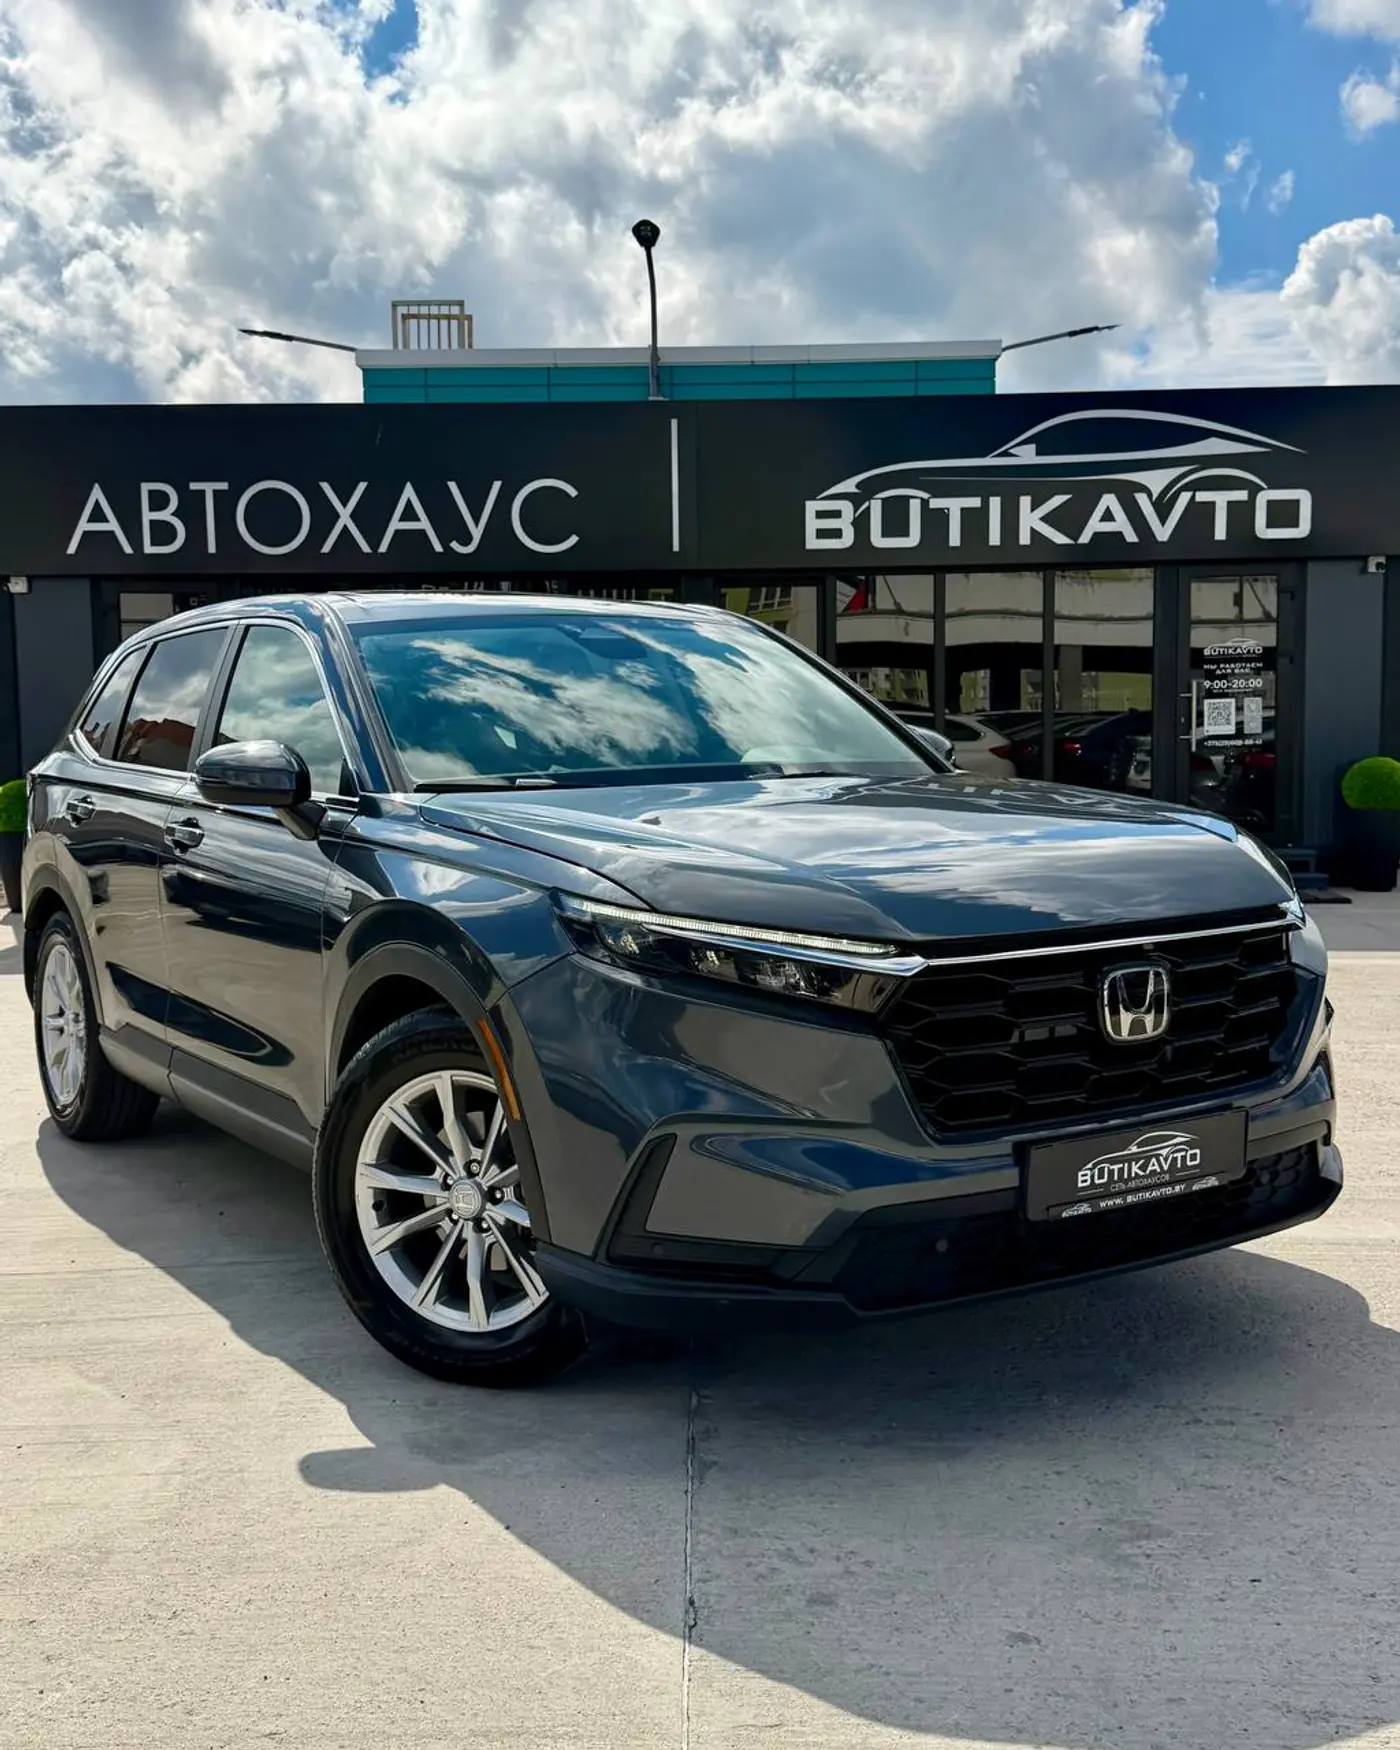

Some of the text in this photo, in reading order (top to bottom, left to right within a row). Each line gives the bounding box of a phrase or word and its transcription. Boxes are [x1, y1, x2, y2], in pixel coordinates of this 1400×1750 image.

[66, 478, 580, 556] АВТОХАУС
[804, 487, 1312, 551] BUTIKAVTO
[1204, 647, 1263, 655] BUTIKAVTO
[1204, 679, 1263, 689] 9:00-20:00
[1077, 1148, 1200, 1188] BUTIKAVTO
